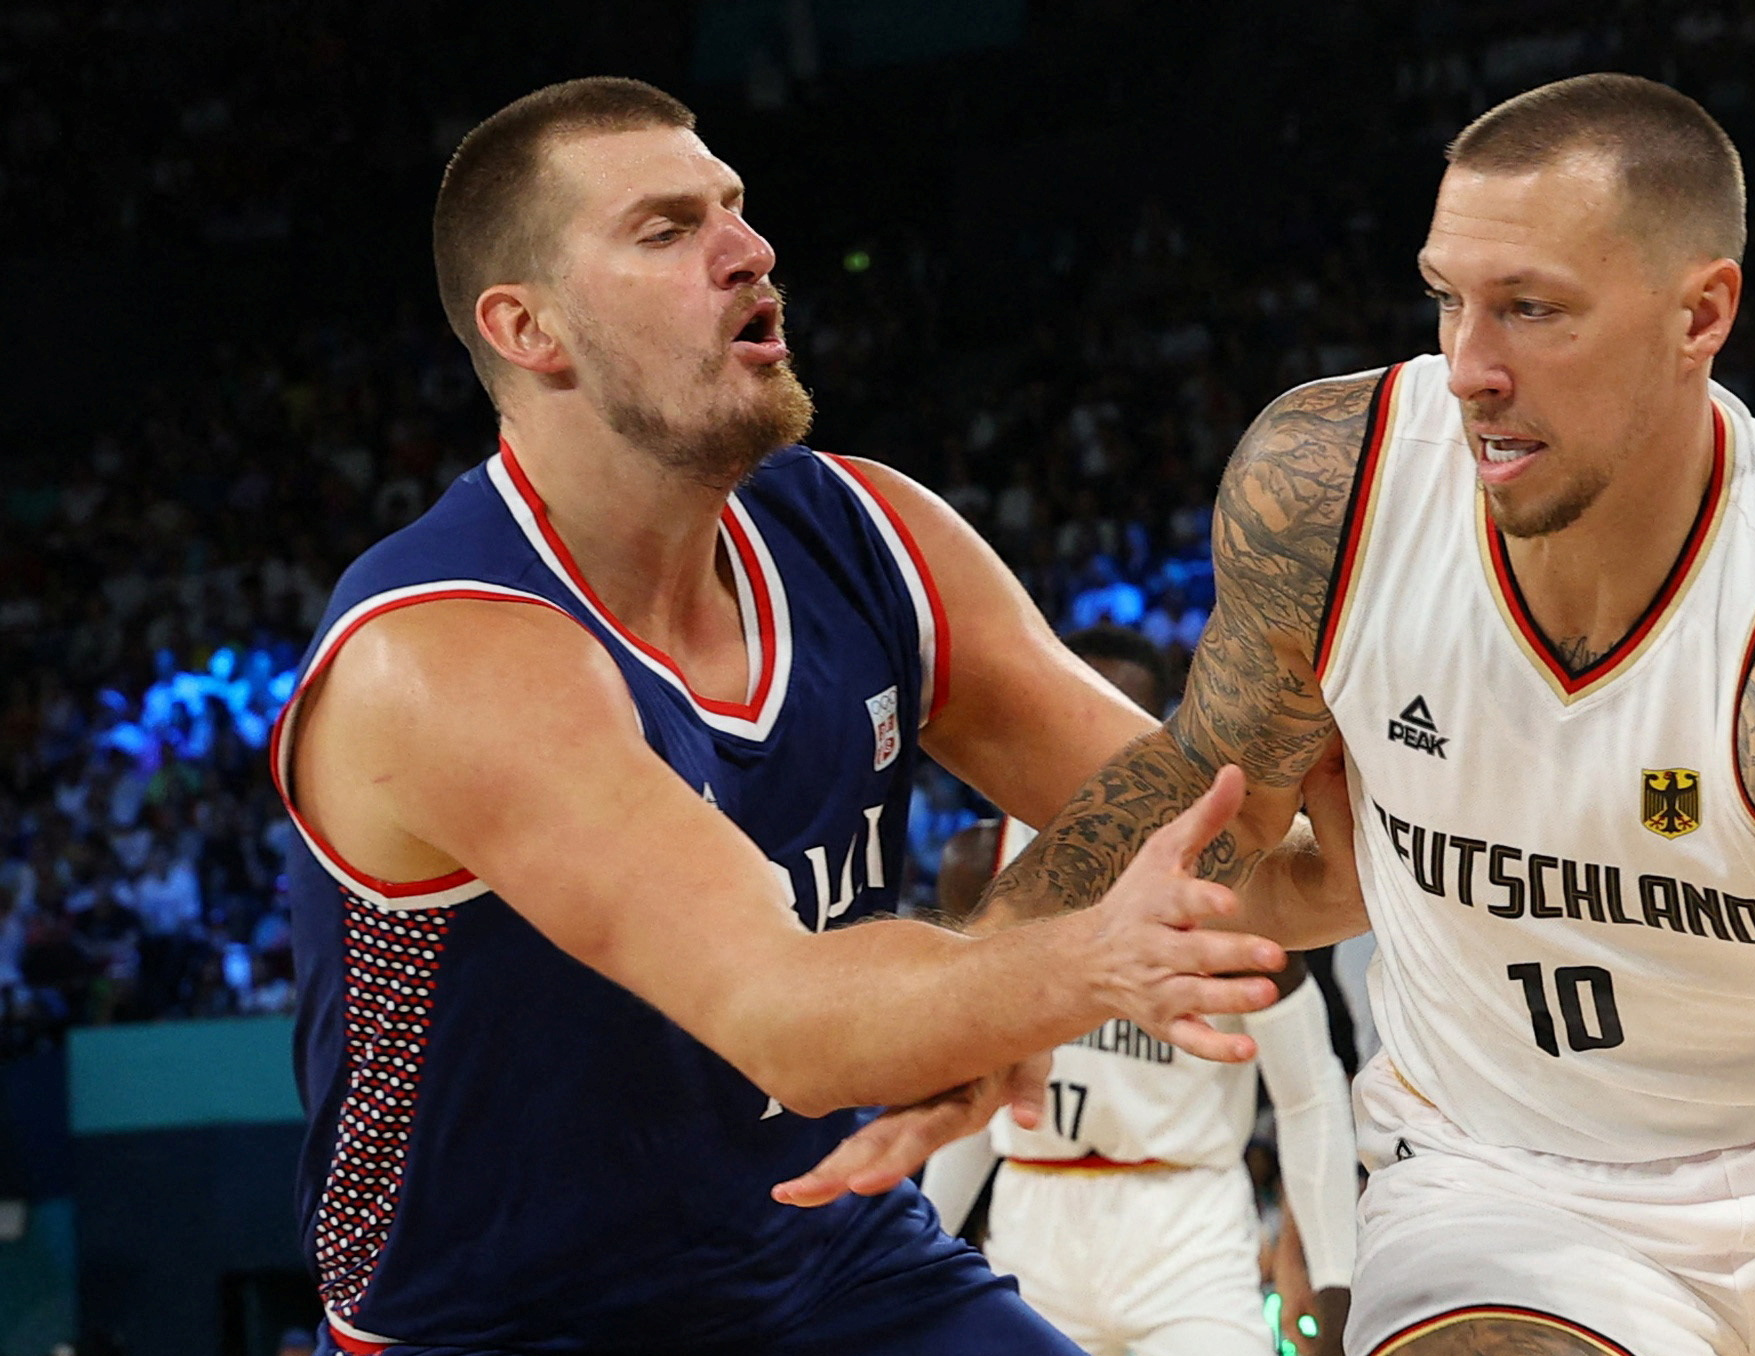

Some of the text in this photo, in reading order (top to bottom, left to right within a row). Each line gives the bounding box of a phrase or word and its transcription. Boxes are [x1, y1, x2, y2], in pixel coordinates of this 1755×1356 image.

[1387, 719, 1450, 760] PEAK
[1507, 962, 1625, 1058] 10
[1049, 1080, 1089, 1142] 17
